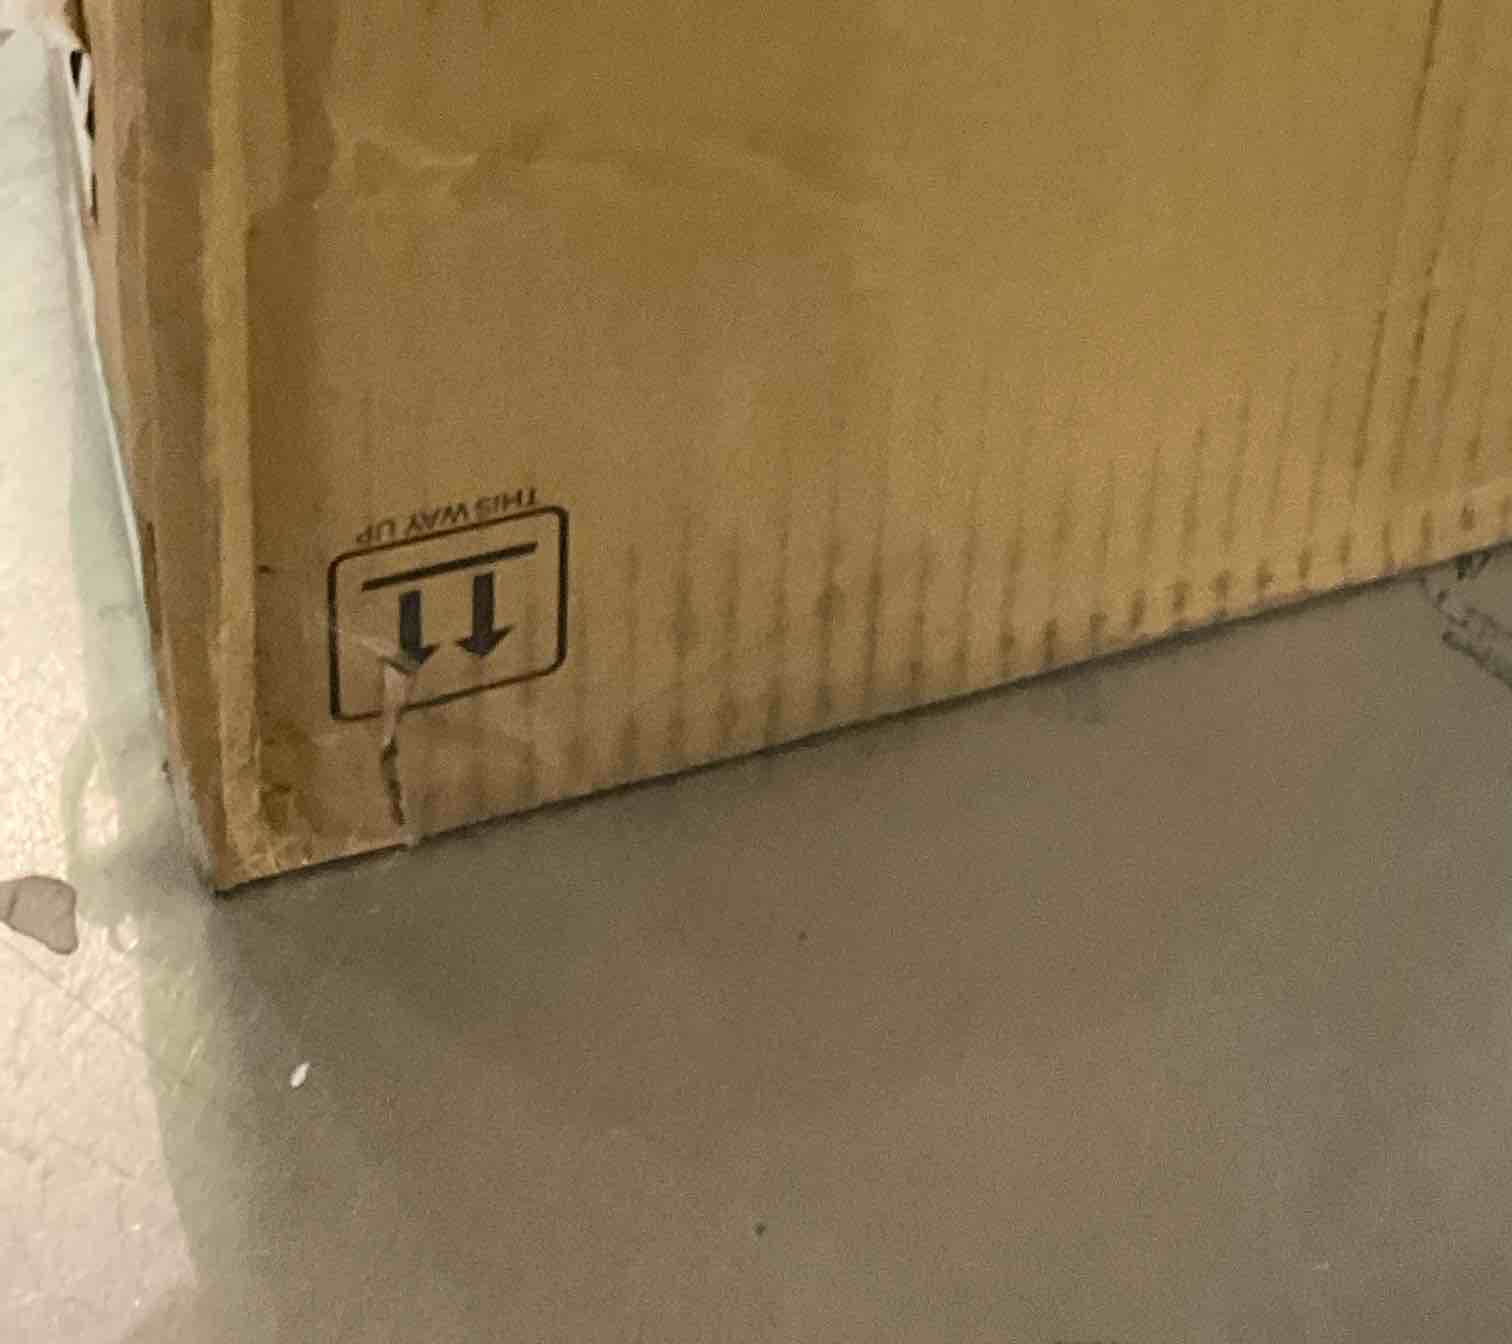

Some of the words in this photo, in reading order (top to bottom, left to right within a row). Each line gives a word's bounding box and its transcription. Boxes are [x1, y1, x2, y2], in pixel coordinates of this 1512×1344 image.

[476, 486, 538, 513] THIS
[406, 501, 468, 533] WAY
[354, 518, 397, 545] UP
